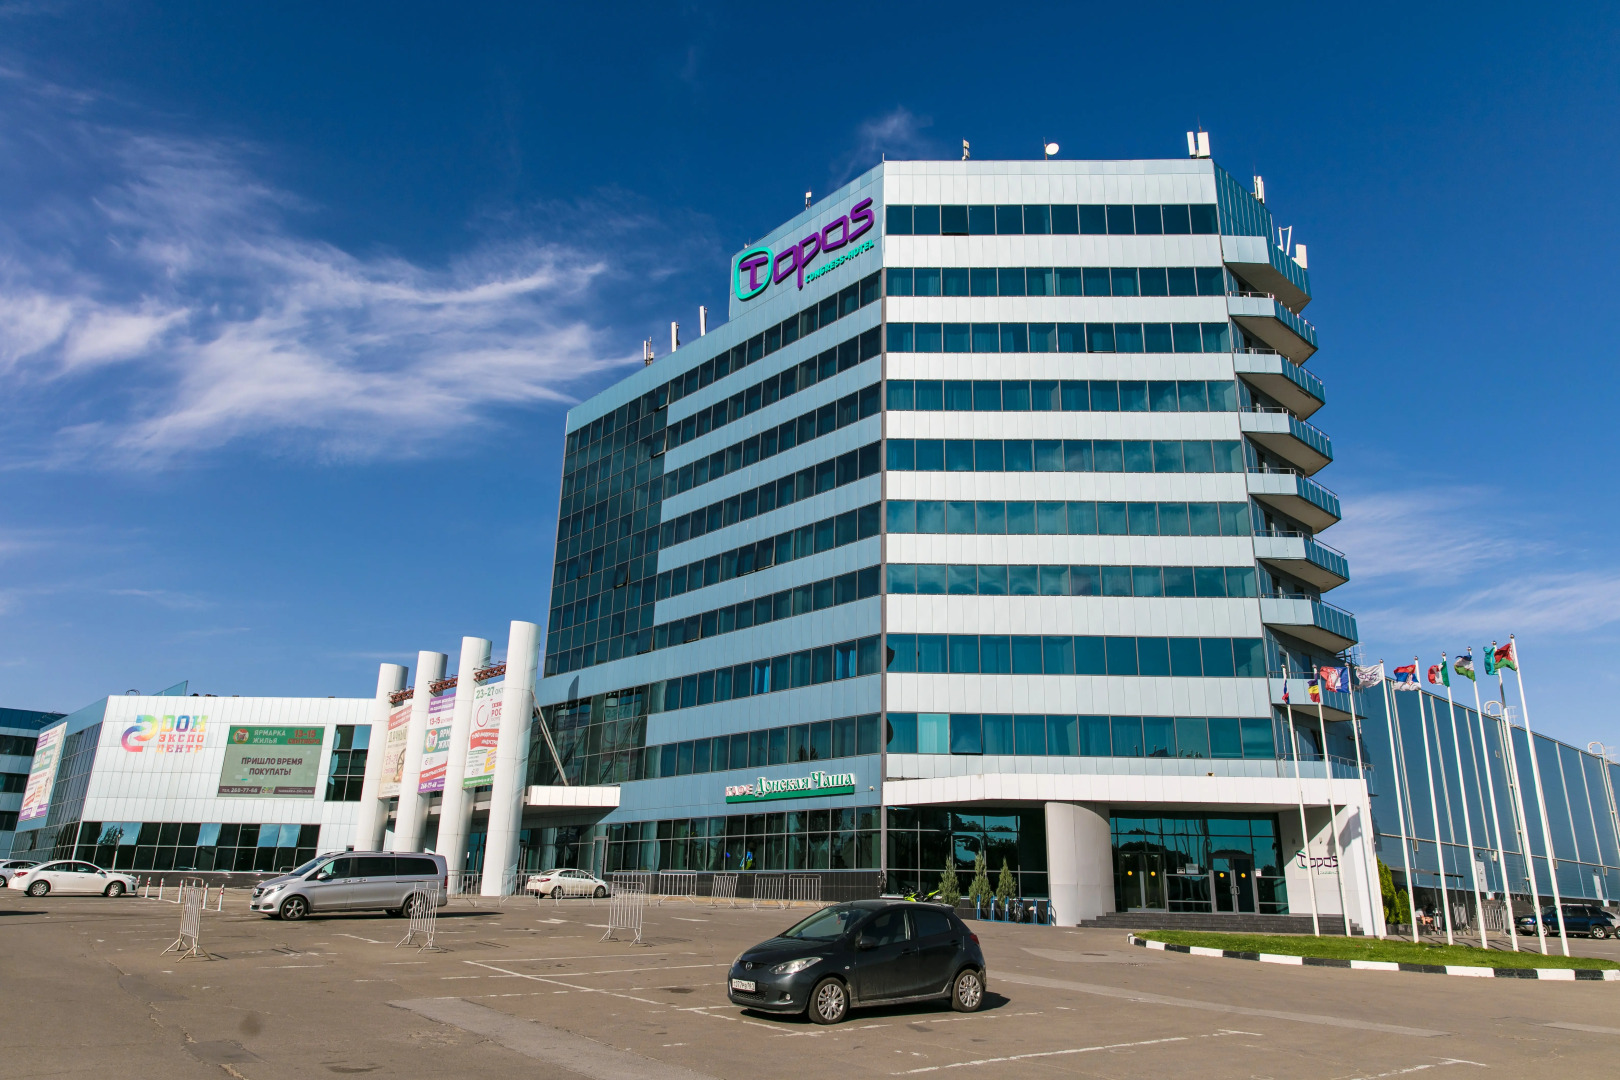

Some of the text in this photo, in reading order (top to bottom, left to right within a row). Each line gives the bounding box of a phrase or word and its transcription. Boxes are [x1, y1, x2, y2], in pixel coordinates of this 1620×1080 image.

[804, 239, 875, 284] CONGRESS-HOTEL
[160, 715, 208, 732] ДОН
[294, 729, 317, 738] 13-15
[158, 734, 204, 743] ЭКСПО
[156, 744, 203, 754] ЦЕНТР
[241, 757, 303, 765] ПРИШЛО ВРЕМЯ
[248, 767, 292, 775] ПОКУПАТЬ!
[725, 771, 855, 797] КАФЕ Донская Чаша
